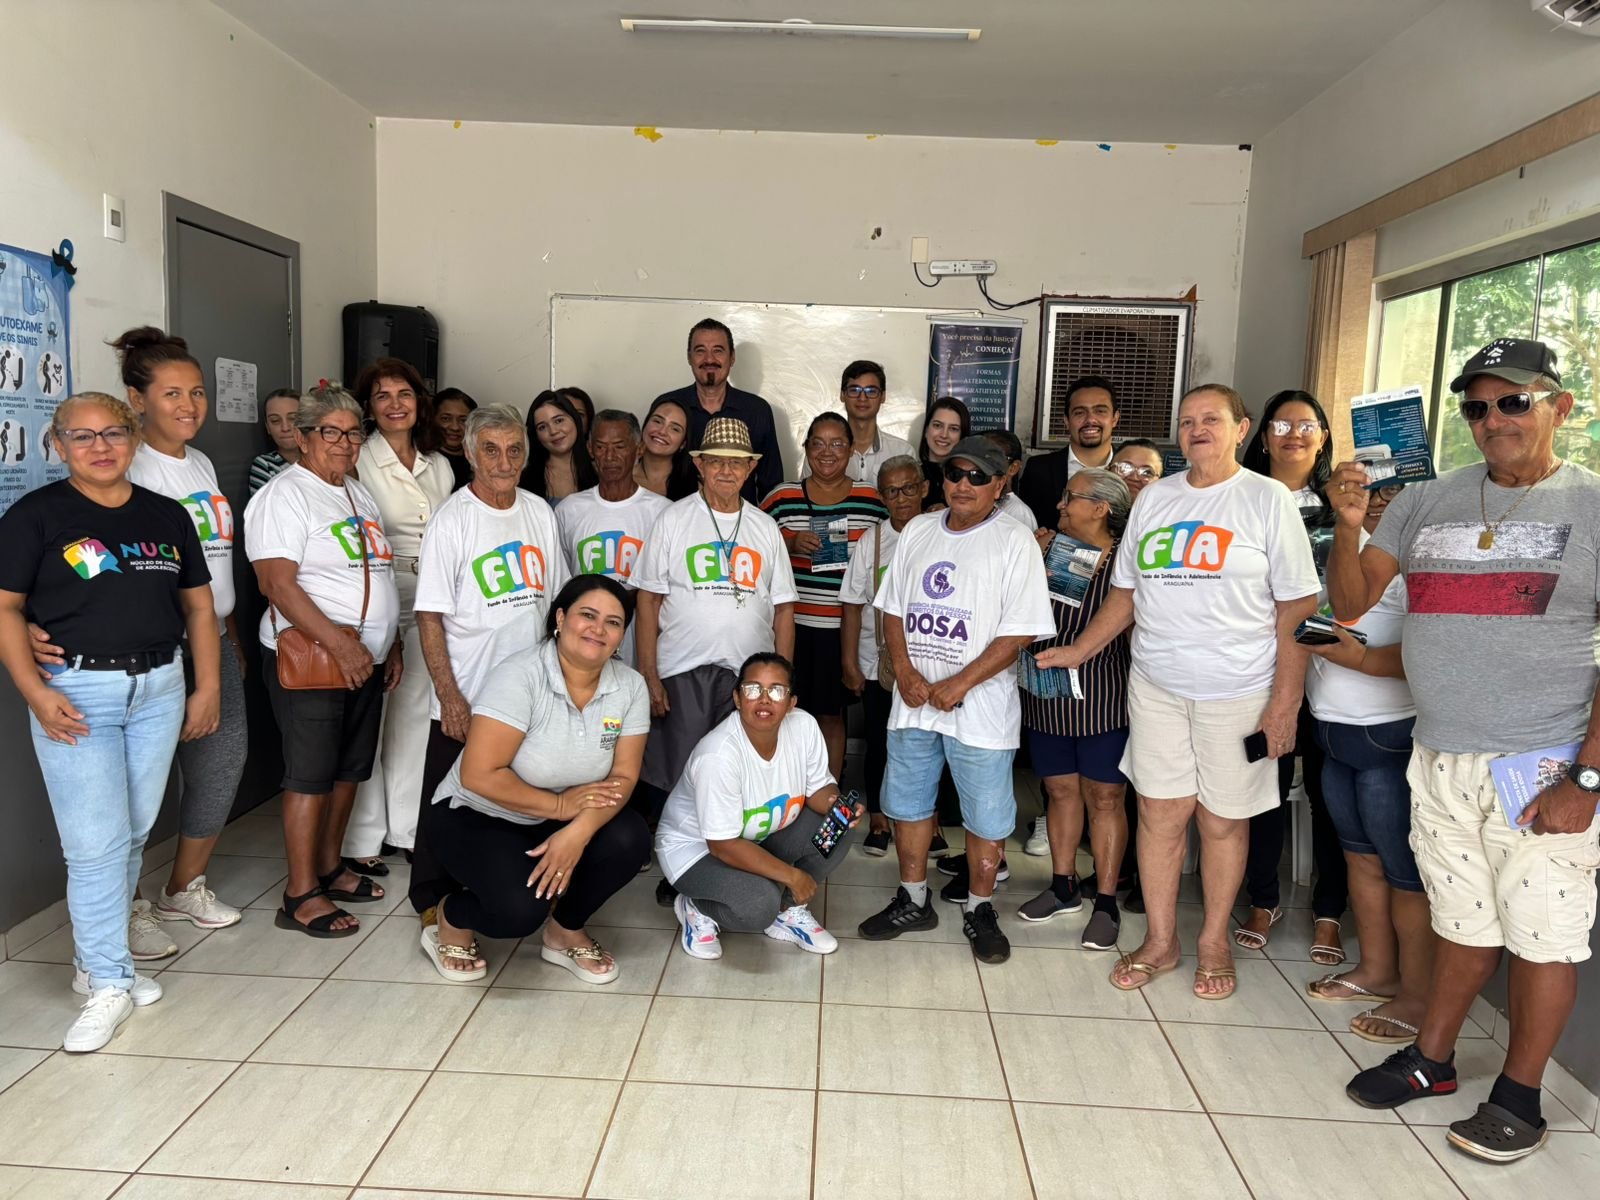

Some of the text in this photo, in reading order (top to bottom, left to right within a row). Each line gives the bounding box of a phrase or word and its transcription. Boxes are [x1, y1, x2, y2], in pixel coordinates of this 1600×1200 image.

[0, 316, 43, 334] UTOEXAME
[17, 335, 38, 346] SINAIS
[975, 345, 1015, 355] CONHEÇA!
[582, 537, 638, 574] FIA
[1143, 529, 1219, 565] FIA
[481, 550, 544, 593] FIA
[694, 548, 755, 582] FIA
[907, 612, 968, 641] DOSA
